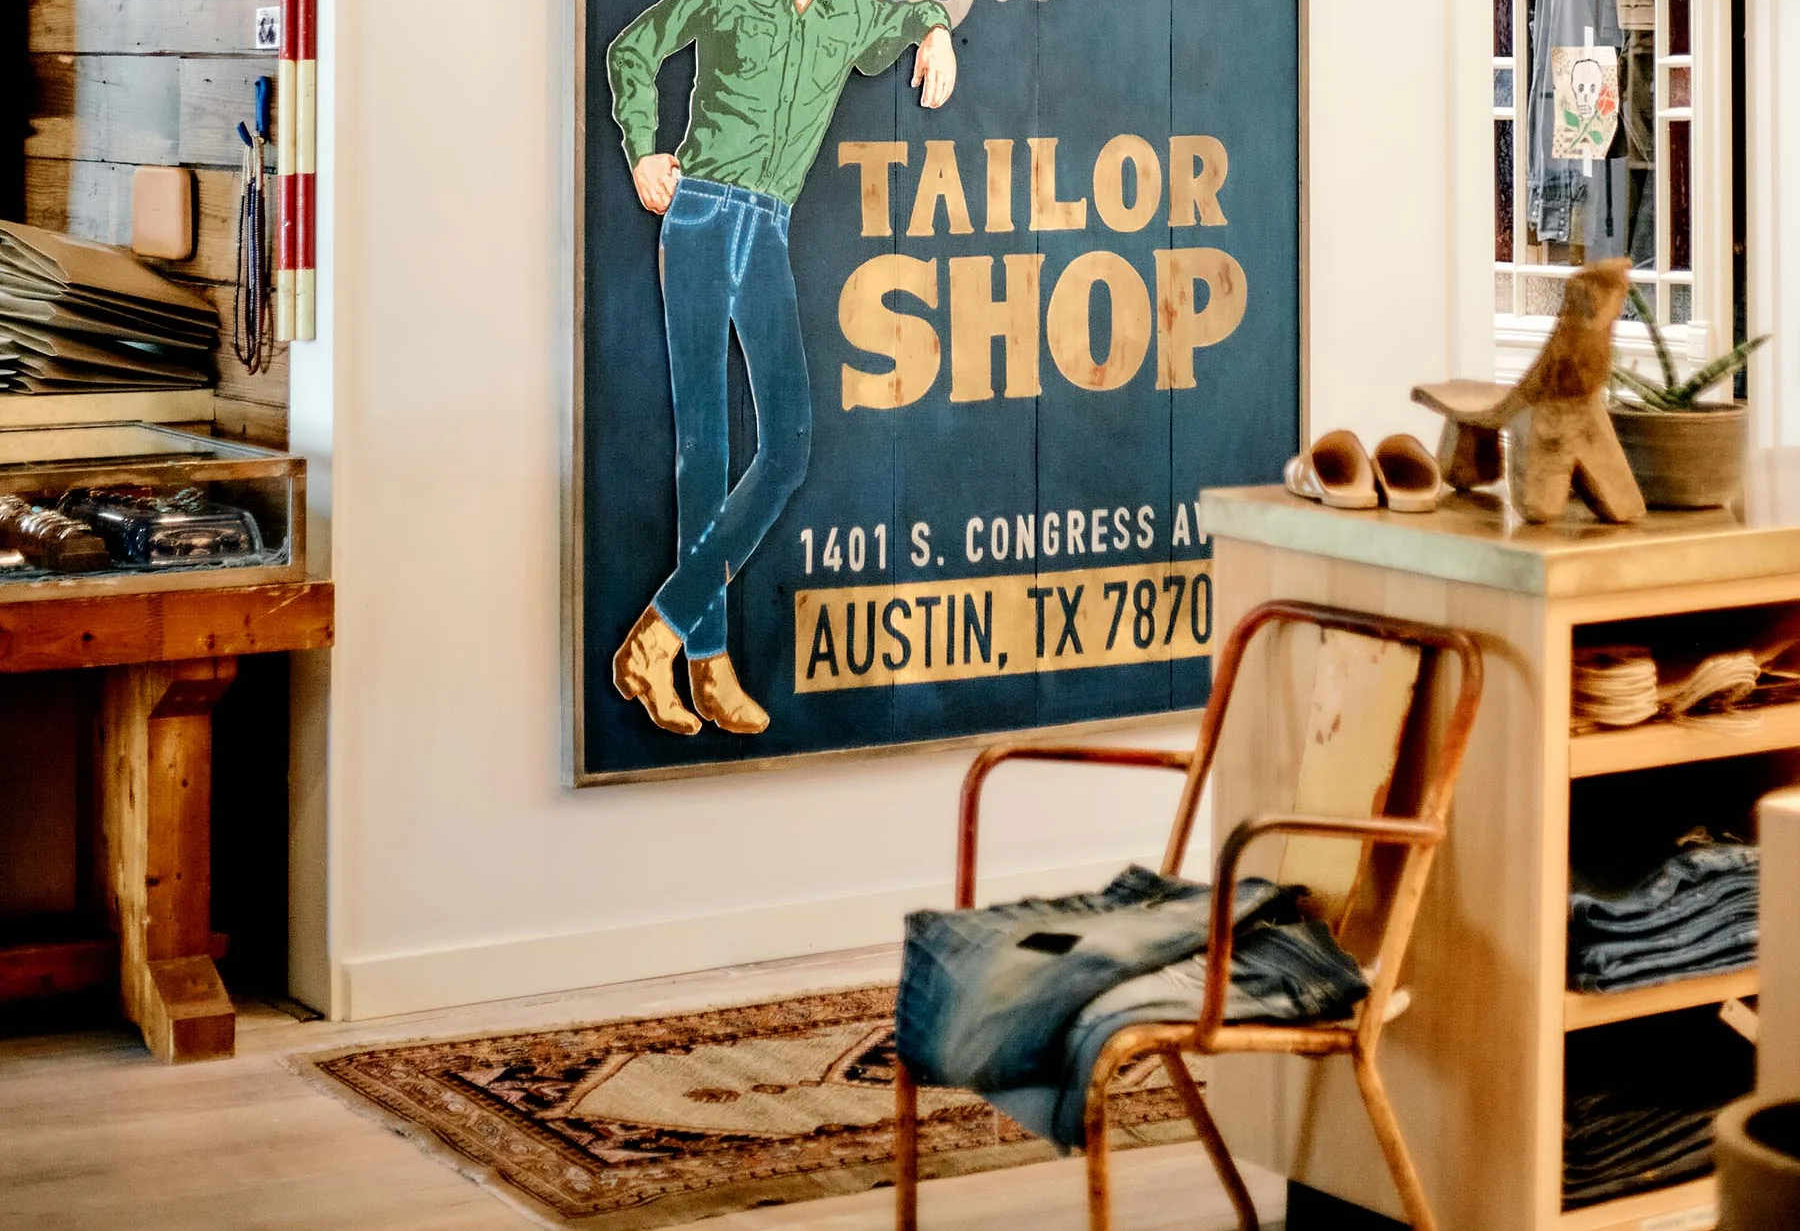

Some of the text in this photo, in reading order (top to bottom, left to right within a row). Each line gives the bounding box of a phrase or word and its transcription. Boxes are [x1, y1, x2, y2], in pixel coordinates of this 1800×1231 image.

[838, 134, 1230, 237] TAILOR
[838, 246, 1248, 411] SHOP
[800, 524, 888, 574] 1401
[910, 522, 946, 568] S.
[966, 505, 1155, 562] CONGRESS
[806, 590, 1009, 681] AUSTIN,
[1027, 584, 1087, 656] TX
